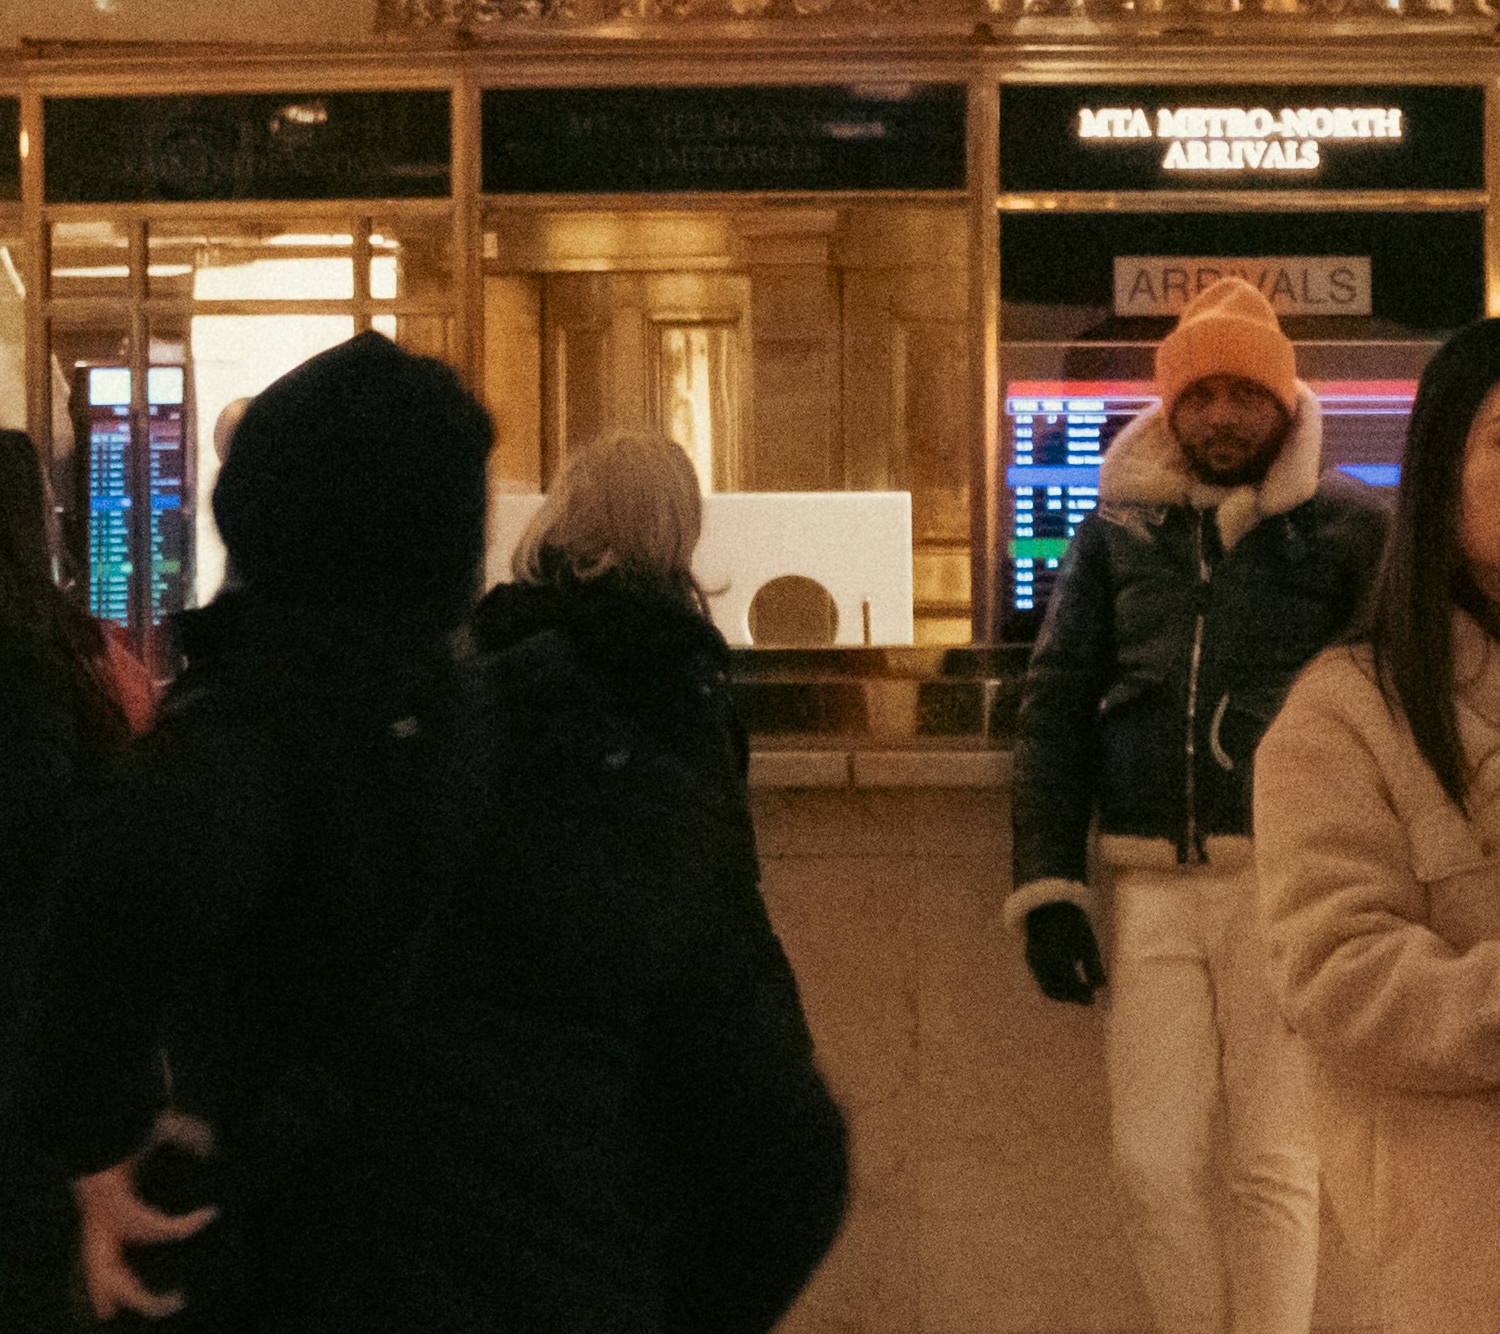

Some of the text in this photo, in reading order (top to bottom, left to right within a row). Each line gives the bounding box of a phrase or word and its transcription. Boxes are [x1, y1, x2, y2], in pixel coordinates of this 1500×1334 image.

[1079, 108, 1401, 138] MTA METRO-NORTH
[1162, 140, 1320, 169] ARRIVALS
[1129, 267, 1358, 305] ARRVALS
